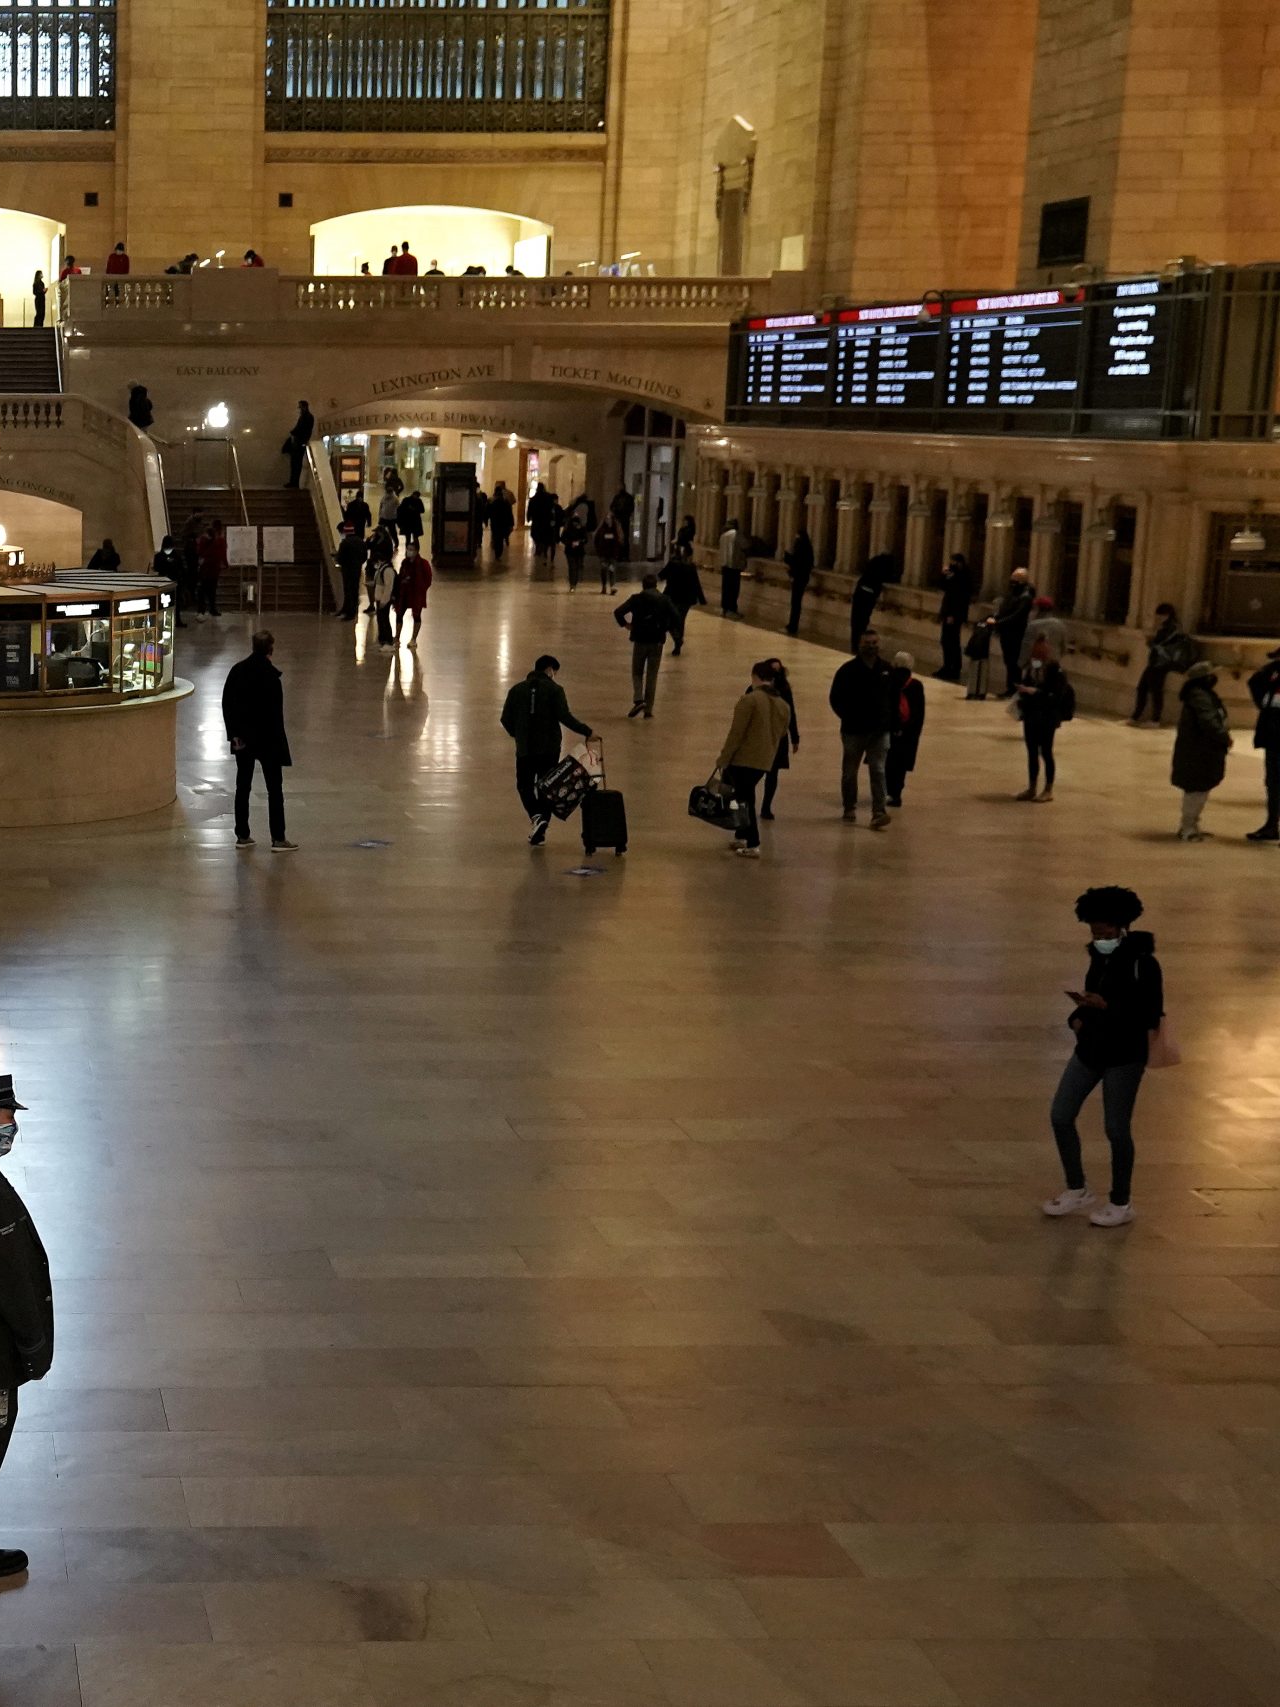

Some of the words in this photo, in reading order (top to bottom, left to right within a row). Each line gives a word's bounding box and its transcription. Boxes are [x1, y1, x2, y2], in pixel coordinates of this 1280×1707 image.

[176, 366, 204, 376] EAST
[206, 366, 261, 377] BALCONY
[372, 368, 462, 395] LEXINGTON
[469, 364, 496, 378] AVE
[549, 365, 600, 381] TICKET
[606, 372, 683, 400] MACHINES
[334, 414, 380, 428] STREET
[384, 411, 436, 424] PASSAGE
[443, 412, 496, 426] SUBWAY
